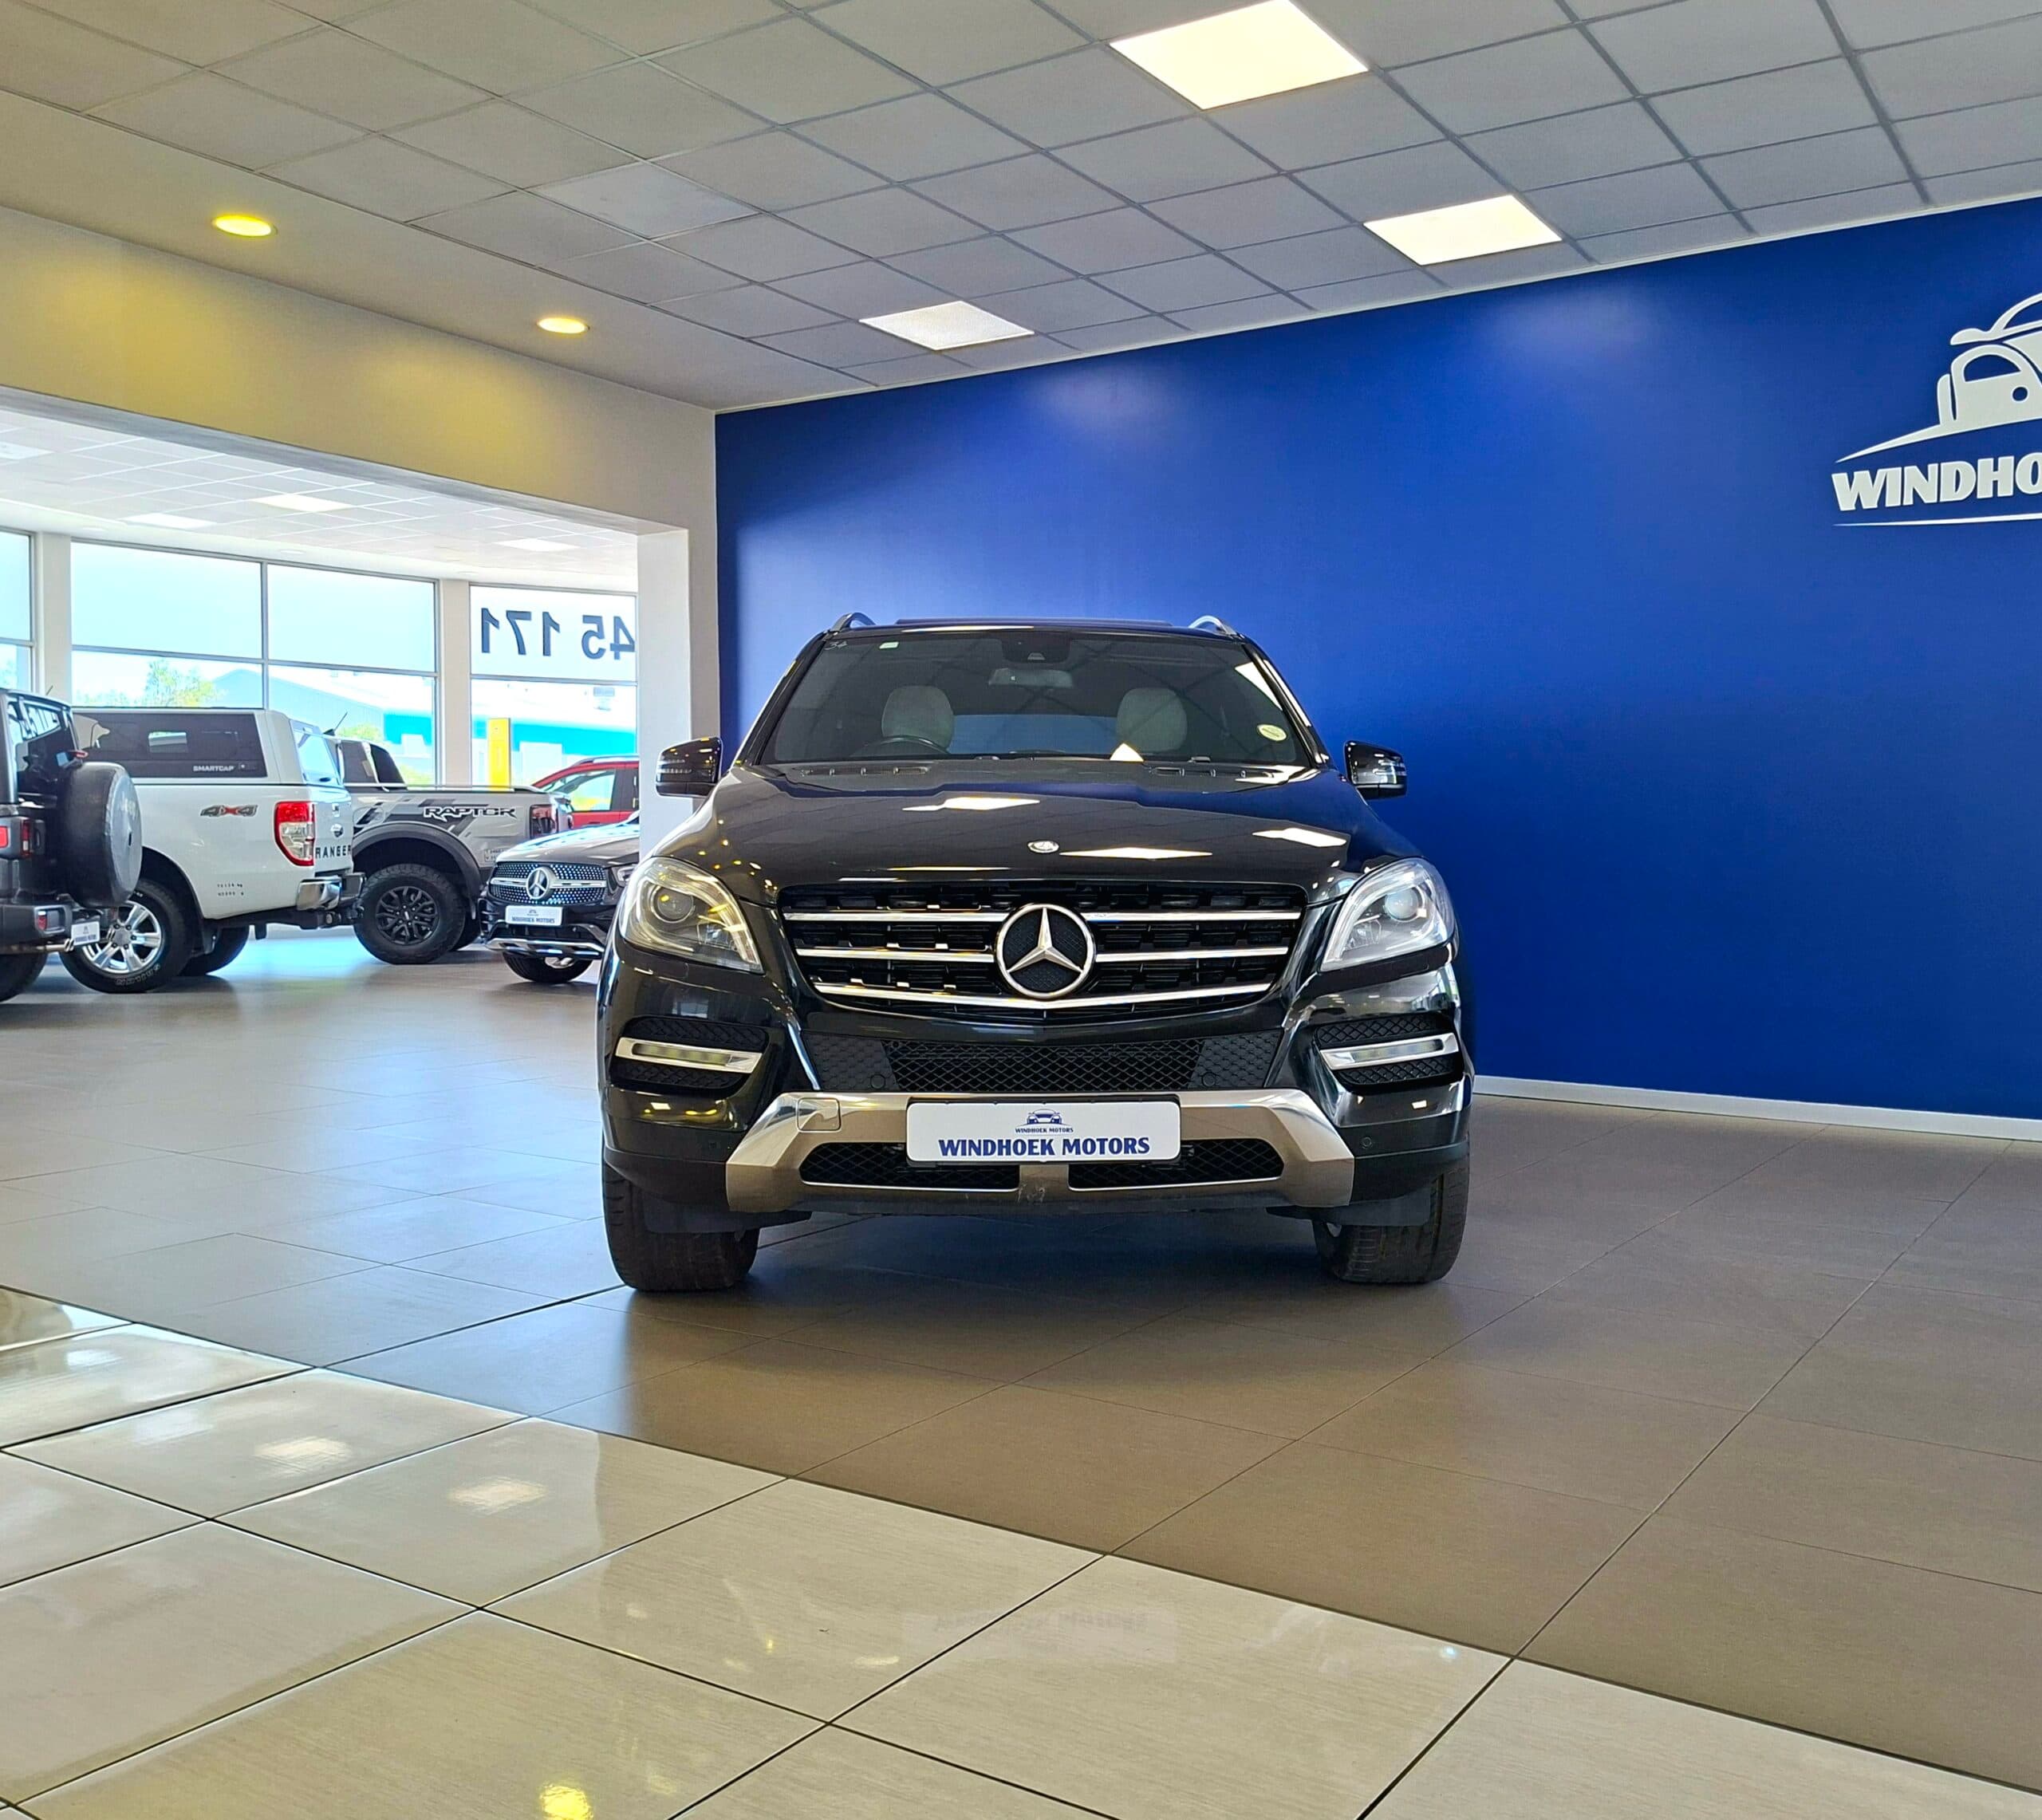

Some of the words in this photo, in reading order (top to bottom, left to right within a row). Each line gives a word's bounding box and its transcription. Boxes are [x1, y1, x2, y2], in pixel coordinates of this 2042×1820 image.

[1831, 452, 2042, 511] WINDHO
[424, 806, 517, 822] RAPTOR
[315, 844, 352, 859] RANGER
[938, 1138, 1056, 1156] WINDHOEK
[1062, 1137, 1150, 1156] MOTORS
